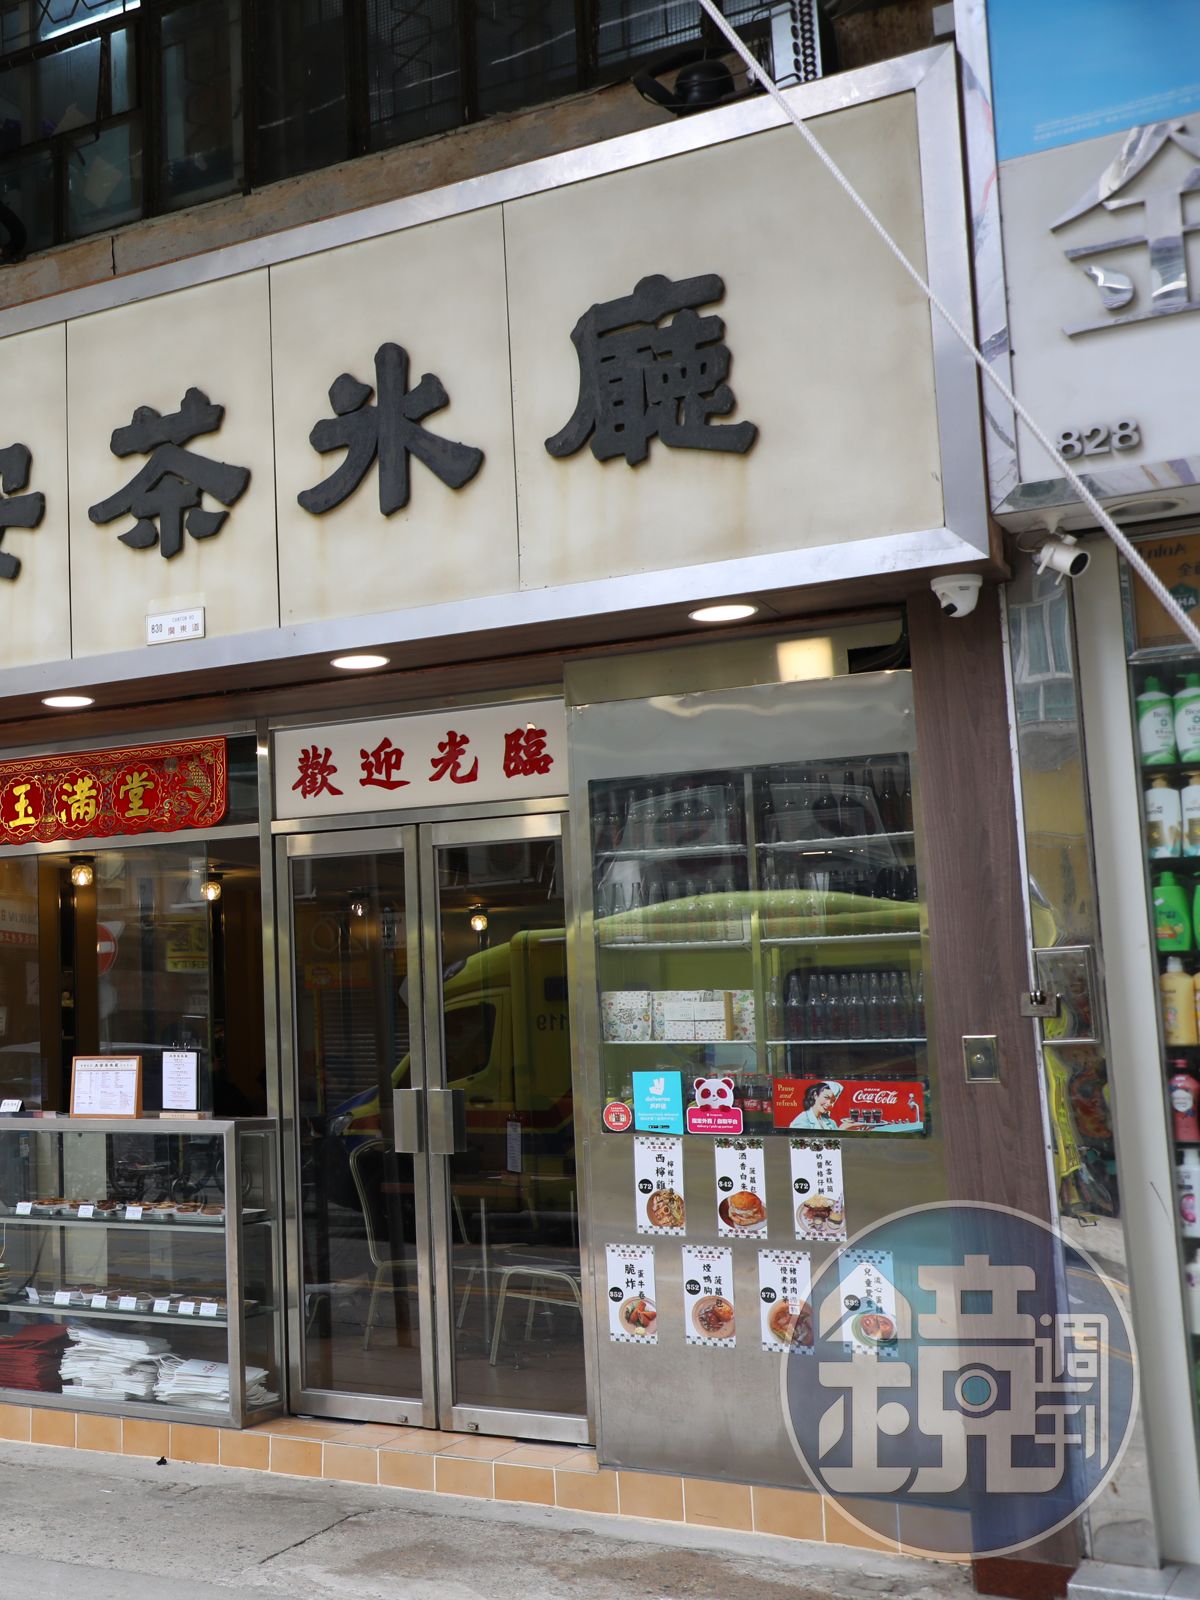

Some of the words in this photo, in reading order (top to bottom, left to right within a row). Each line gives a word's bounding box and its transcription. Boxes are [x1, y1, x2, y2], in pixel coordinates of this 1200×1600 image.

[1056, 417, 1140, 461] 828
[291, 726, 554, 800] 歡迎光臨
[777, 1084, 795, 1092] Pause
[776, 1099, 798, 1107] refresh
